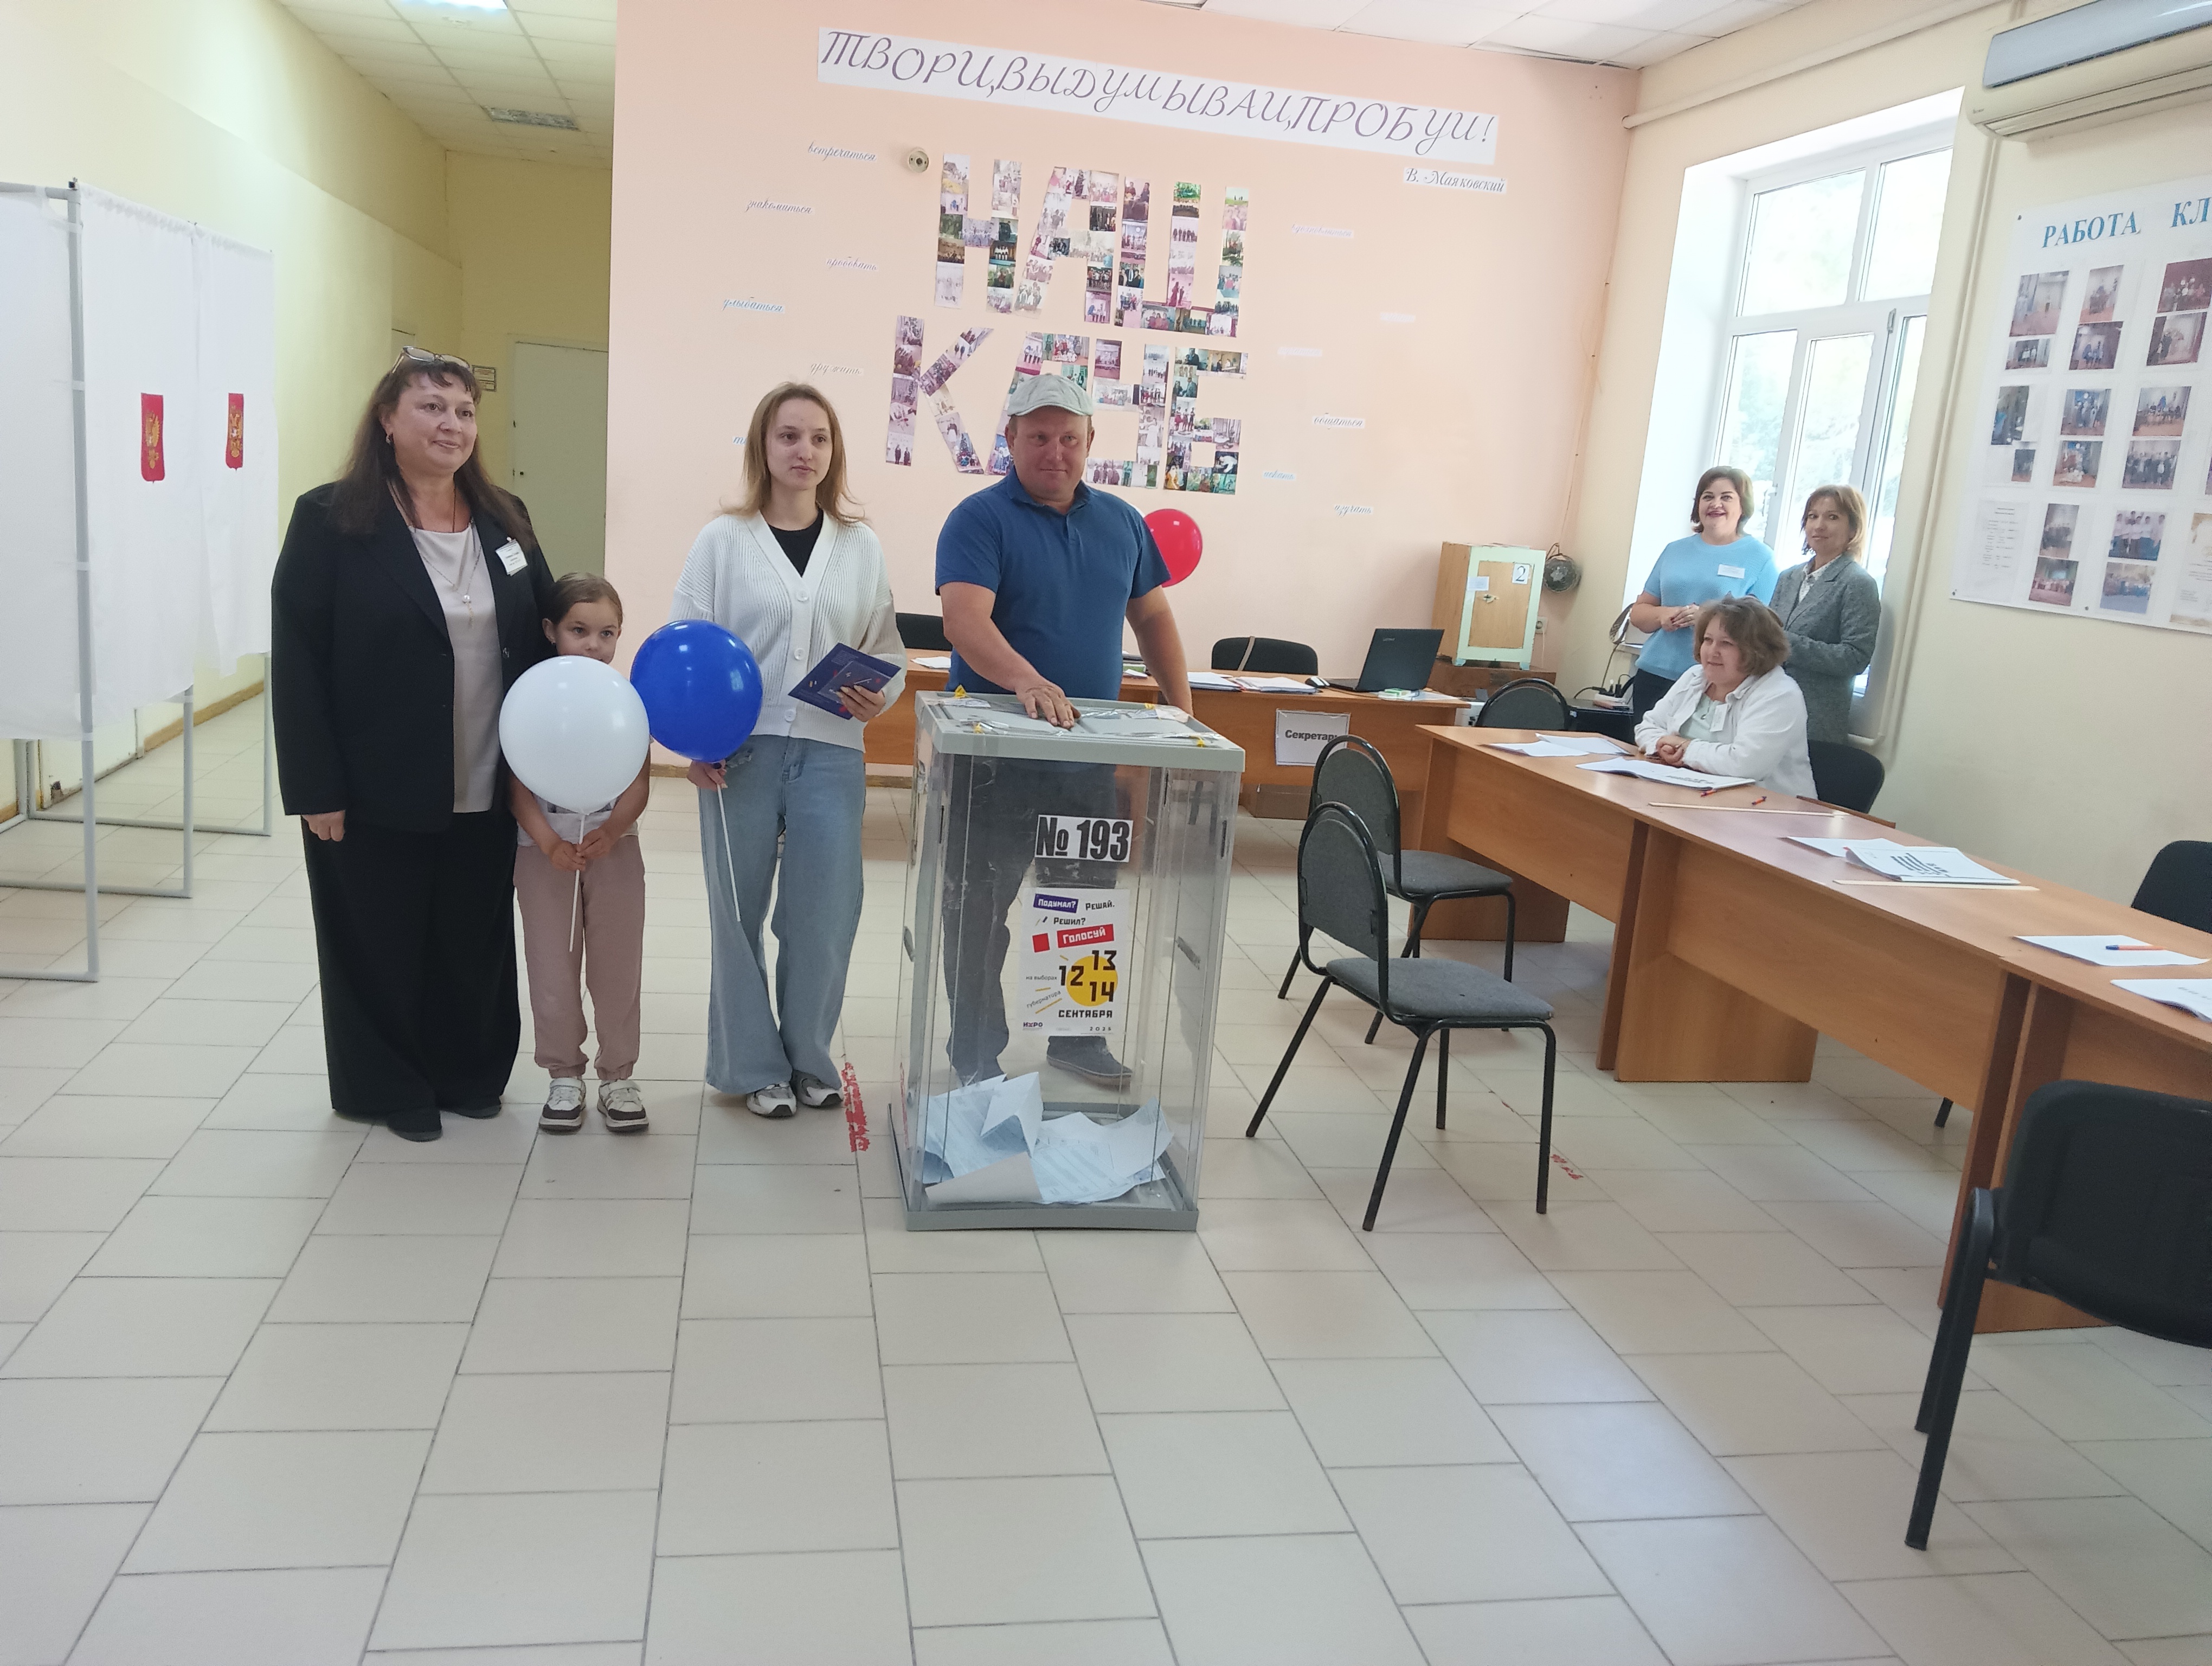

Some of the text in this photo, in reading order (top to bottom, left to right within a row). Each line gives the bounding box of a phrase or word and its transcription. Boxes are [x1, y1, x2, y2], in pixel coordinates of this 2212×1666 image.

[807, 140, 877, 161] встречаться
[1406, 168, 1506, 193] В. Маяковский
[744, 197, 813, 214] знакомиться
[2041, 210, 2138, 248] РАБОТА
[825, 255, 878, 271] пробовать
[721, 296, 784, 313] улыбаться
[1515, 566, 1526, 582] 2
[1036, 816, 1130, 861] № 193
[1092, 950, 1117, 971] 13
[1058, 965, 1084, 986] 12
[1026, 990, 1061, 1009] губернатора
[1089, 981, 1115, 1002] 14
[1058, 1009, 1113, 1018] СЕНТЯБРЯ
